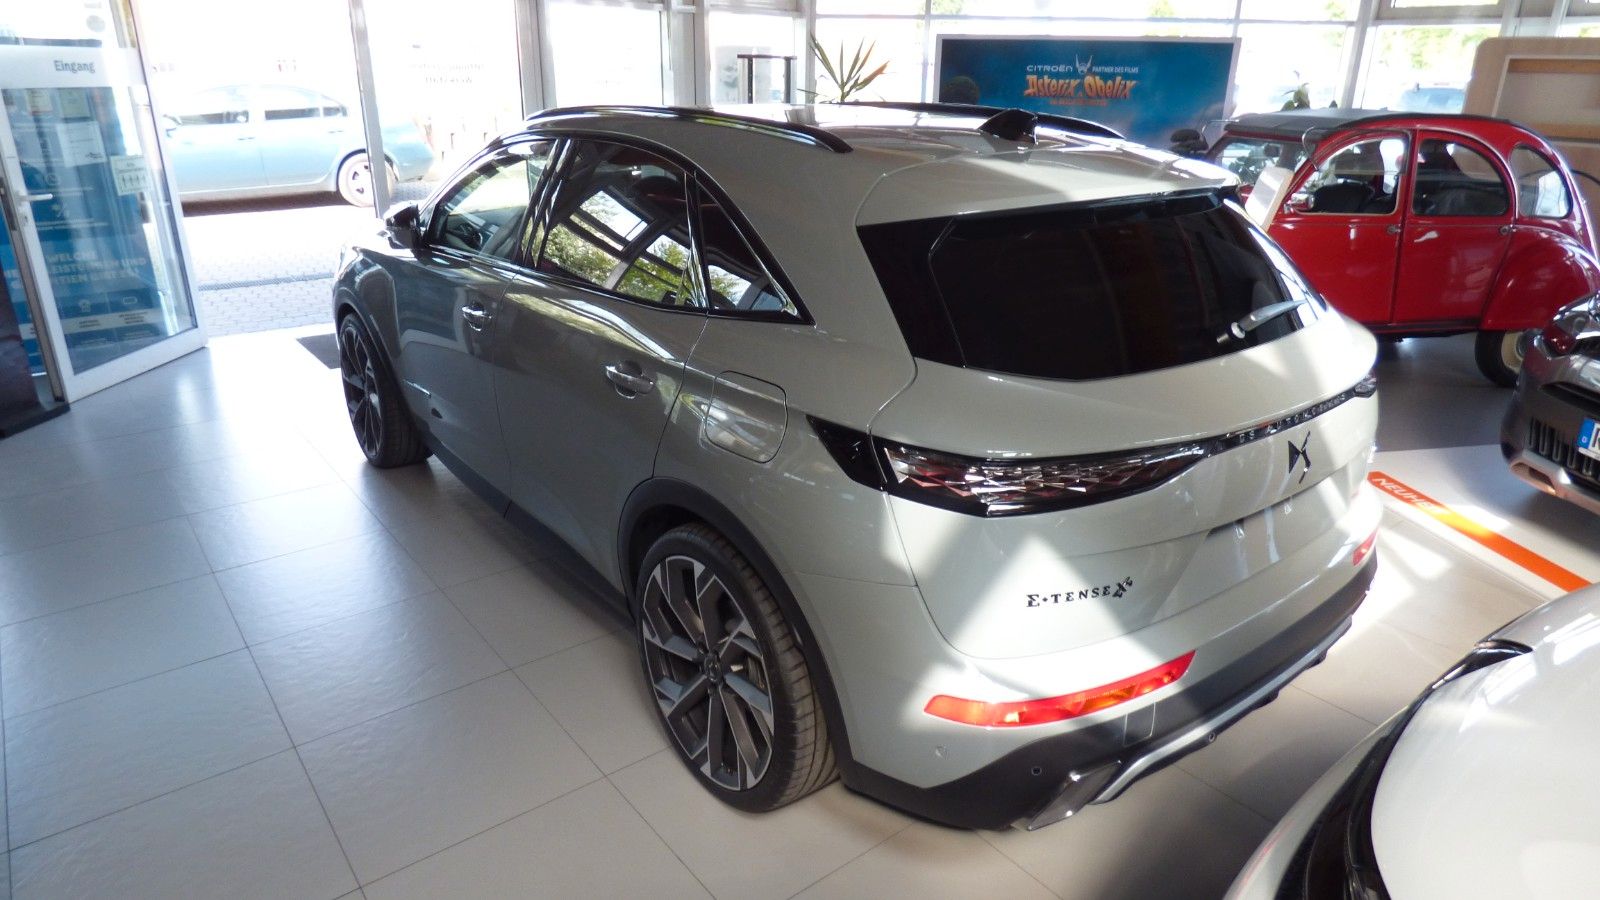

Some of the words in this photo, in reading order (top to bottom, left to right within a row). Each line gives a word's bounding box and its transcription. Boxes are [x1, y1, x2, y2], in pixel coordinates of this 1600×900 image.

[54, 60, 96, 74] Eingang
[1024, 74, 1080, 97] Asterix
[1084, 75, 1137, 98] Obelix
[1239, 430, 1255, 443] DS
